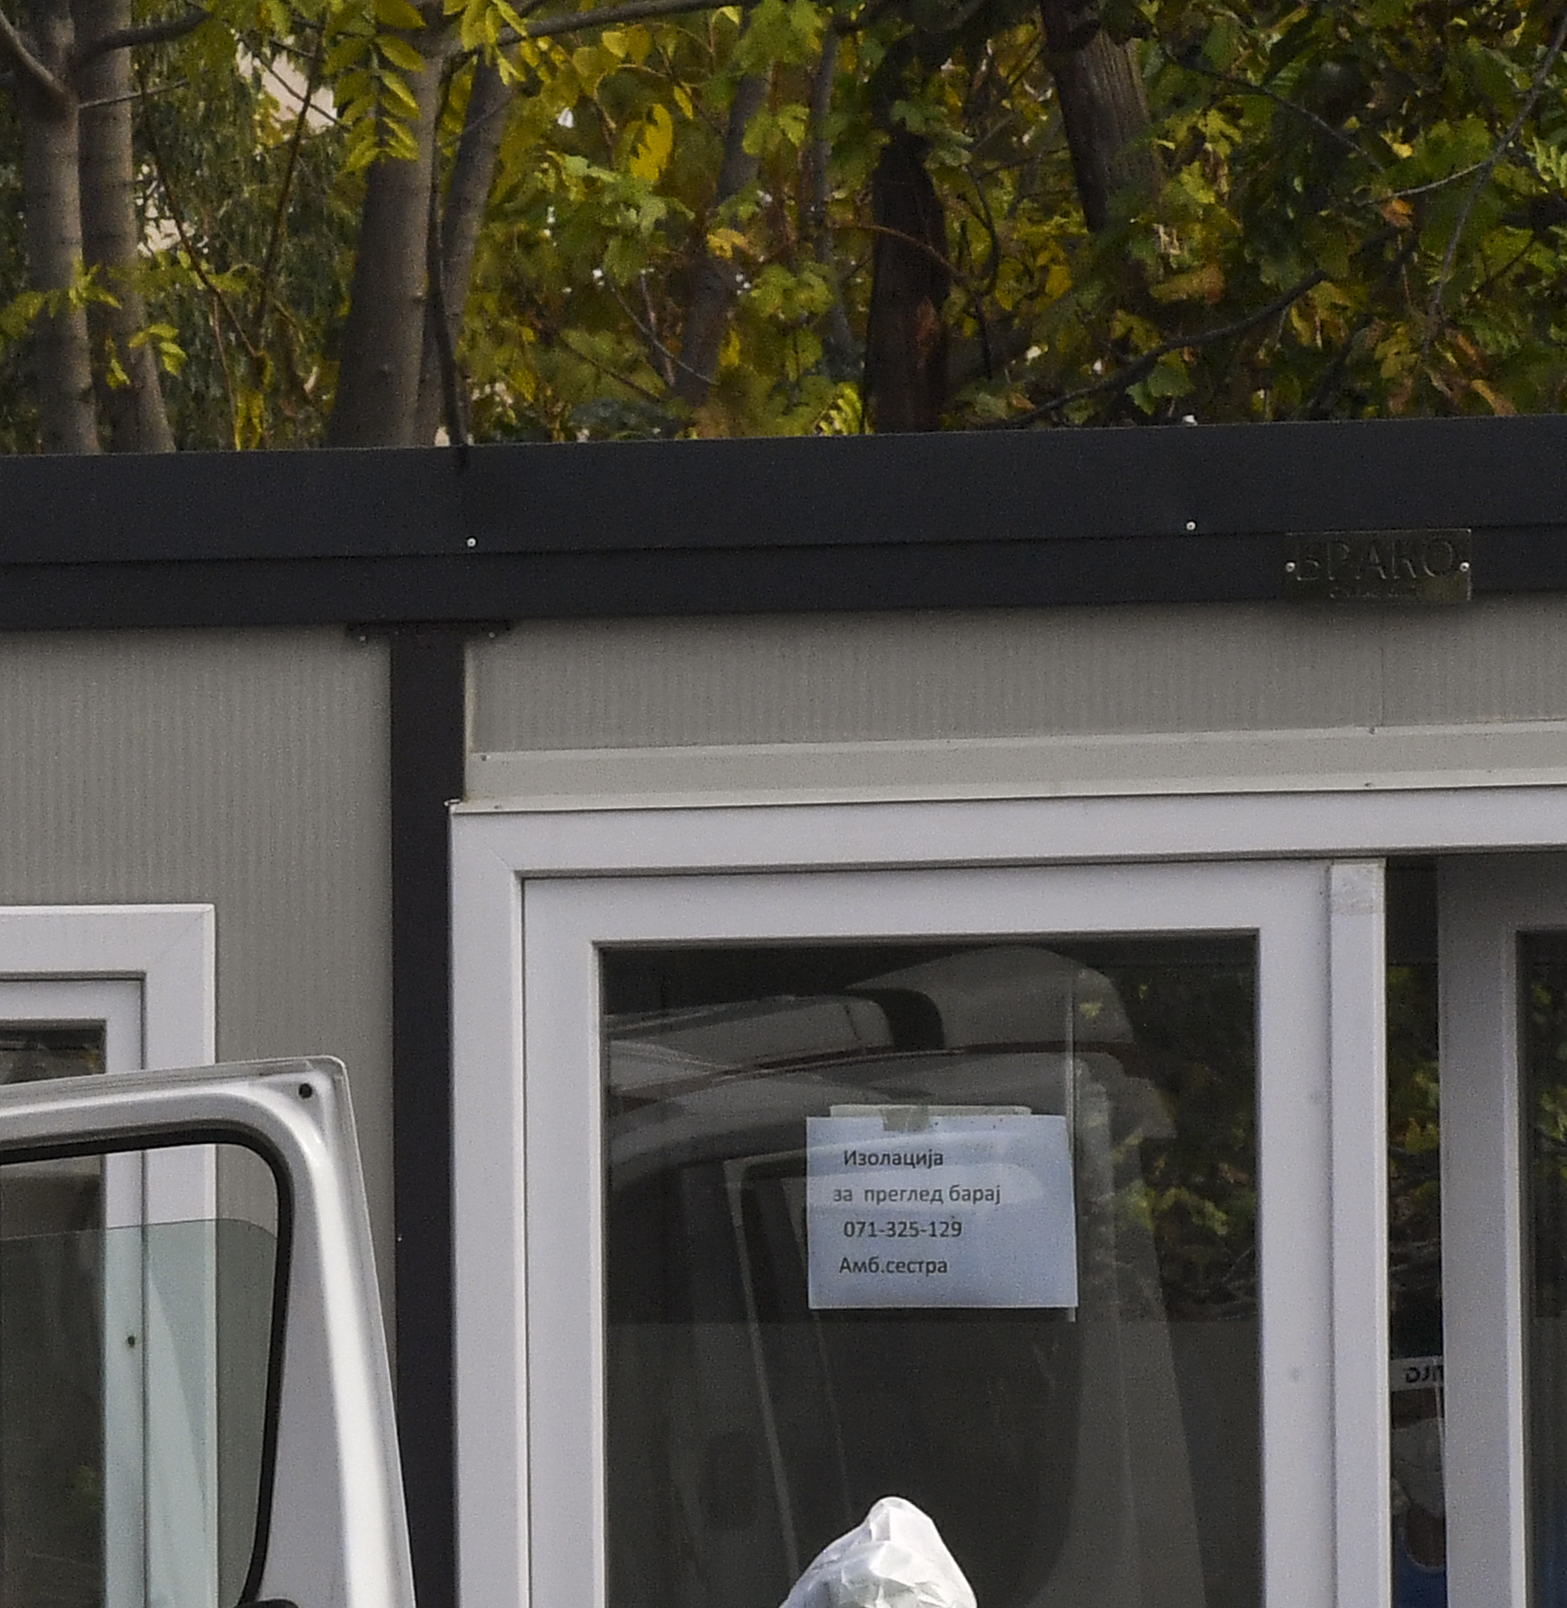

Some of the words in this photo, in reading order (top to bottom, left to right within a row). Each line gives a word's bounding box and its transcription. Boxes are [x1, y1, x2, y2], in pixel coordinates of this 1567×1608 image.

[844, 1149, 944, 1169] Изолација
[833, 1188, 853, 1202] за
[864, 1188, 943, 1205] преглед
[949, 1184, 1001, 1205] барај
[843, 1221, 962, 1238] 071-325-129
[839, 1256, 948, 1277] Амб.сестра
